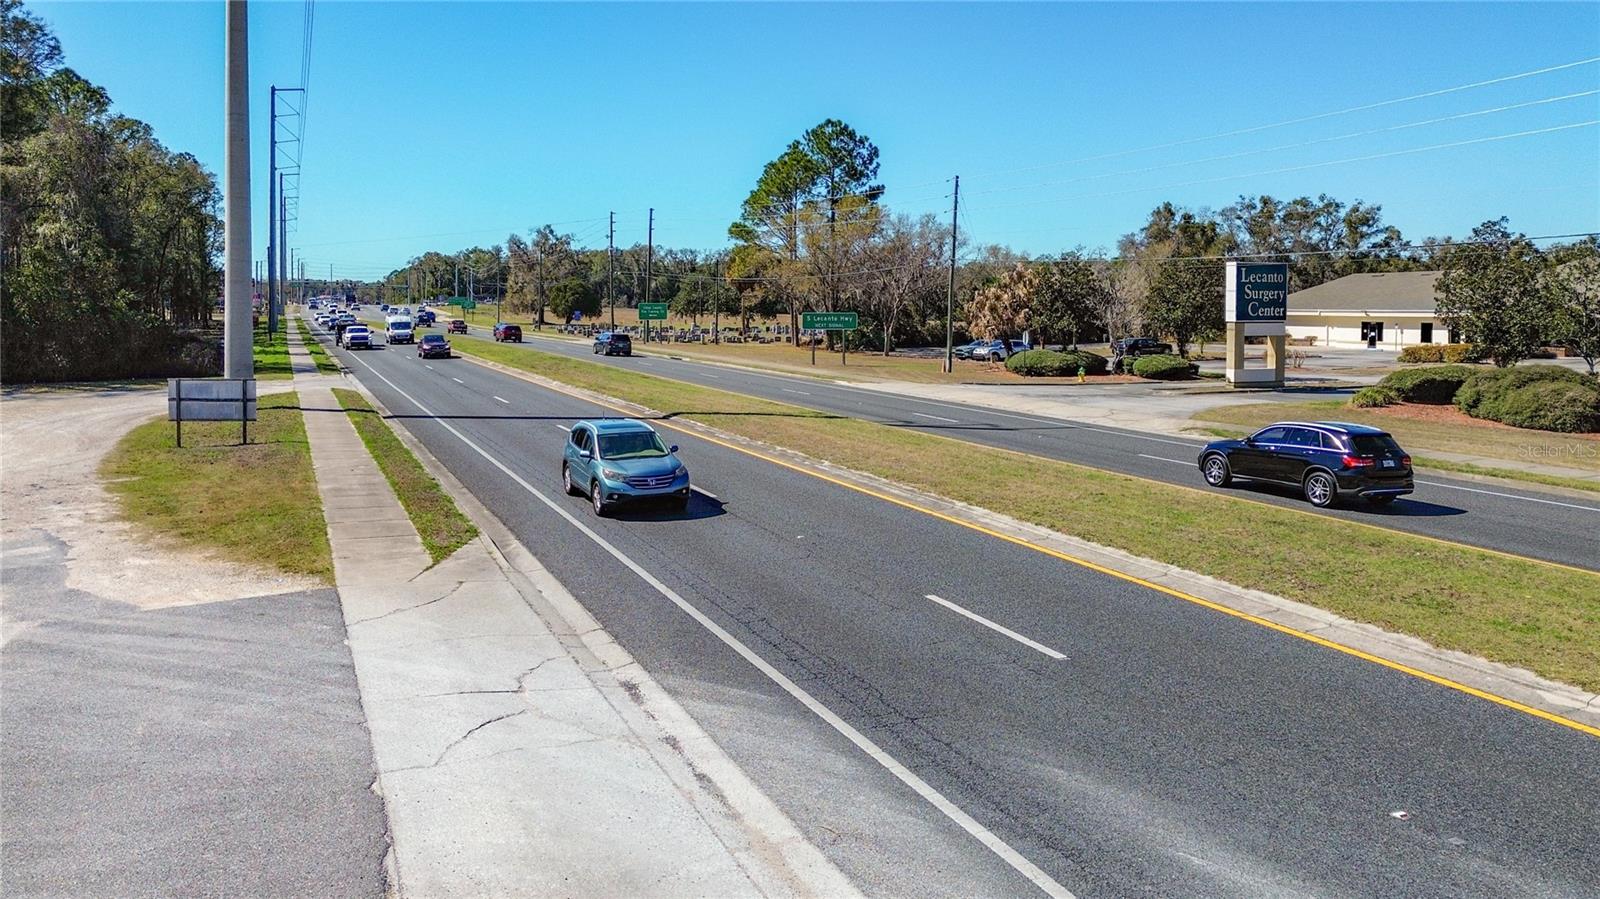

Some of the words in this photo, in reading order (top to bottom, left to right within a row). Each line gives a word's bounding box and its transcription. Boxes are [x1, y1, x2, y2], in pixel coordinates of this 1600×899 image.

[1240, 267, 1284, 283] Lecanto
[1244, 284, 1285, 302] Surgery
[1248, 301, 1285, 317] Center
[840, 315, 853, 323] Hwy
